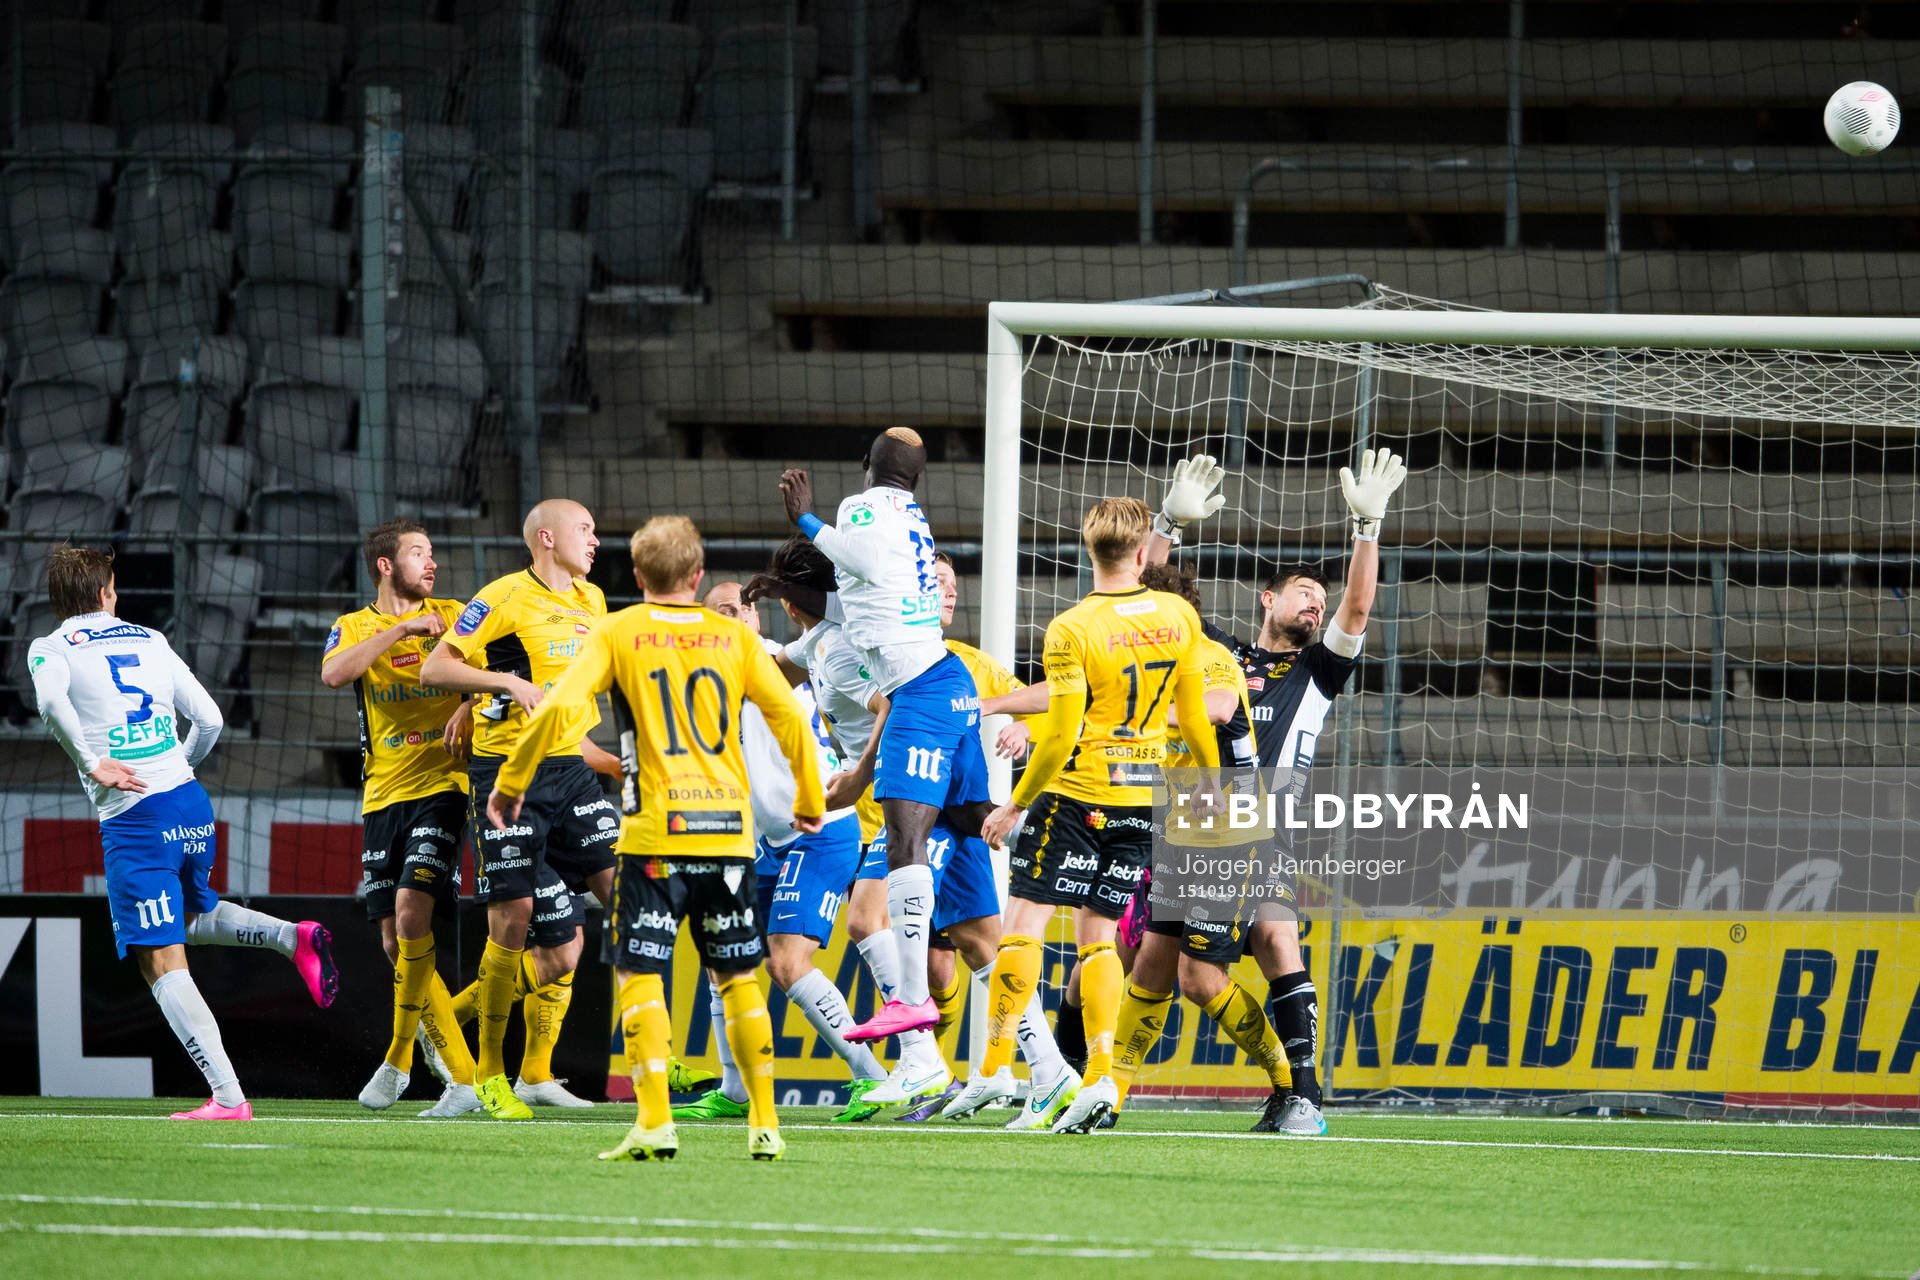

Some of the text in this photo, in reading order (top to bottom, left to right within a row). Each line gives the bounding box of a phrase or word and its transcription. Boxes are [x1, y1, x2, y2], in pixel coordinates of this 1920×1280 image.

[634, 632, 732, 650] PULSEN
[1109, 624, 1181, 652] PULSEN
[104, 653, 154, 724] 5
[1112, 660, 1177, 738] 17
[108, 715, 173, 748] SEFAB
[649, 666, 729, 757] 10
[477, 876, 491, 895] 12
[904, 895, 925, 941] SITA
[815, 990, 848, 1030] SITA
